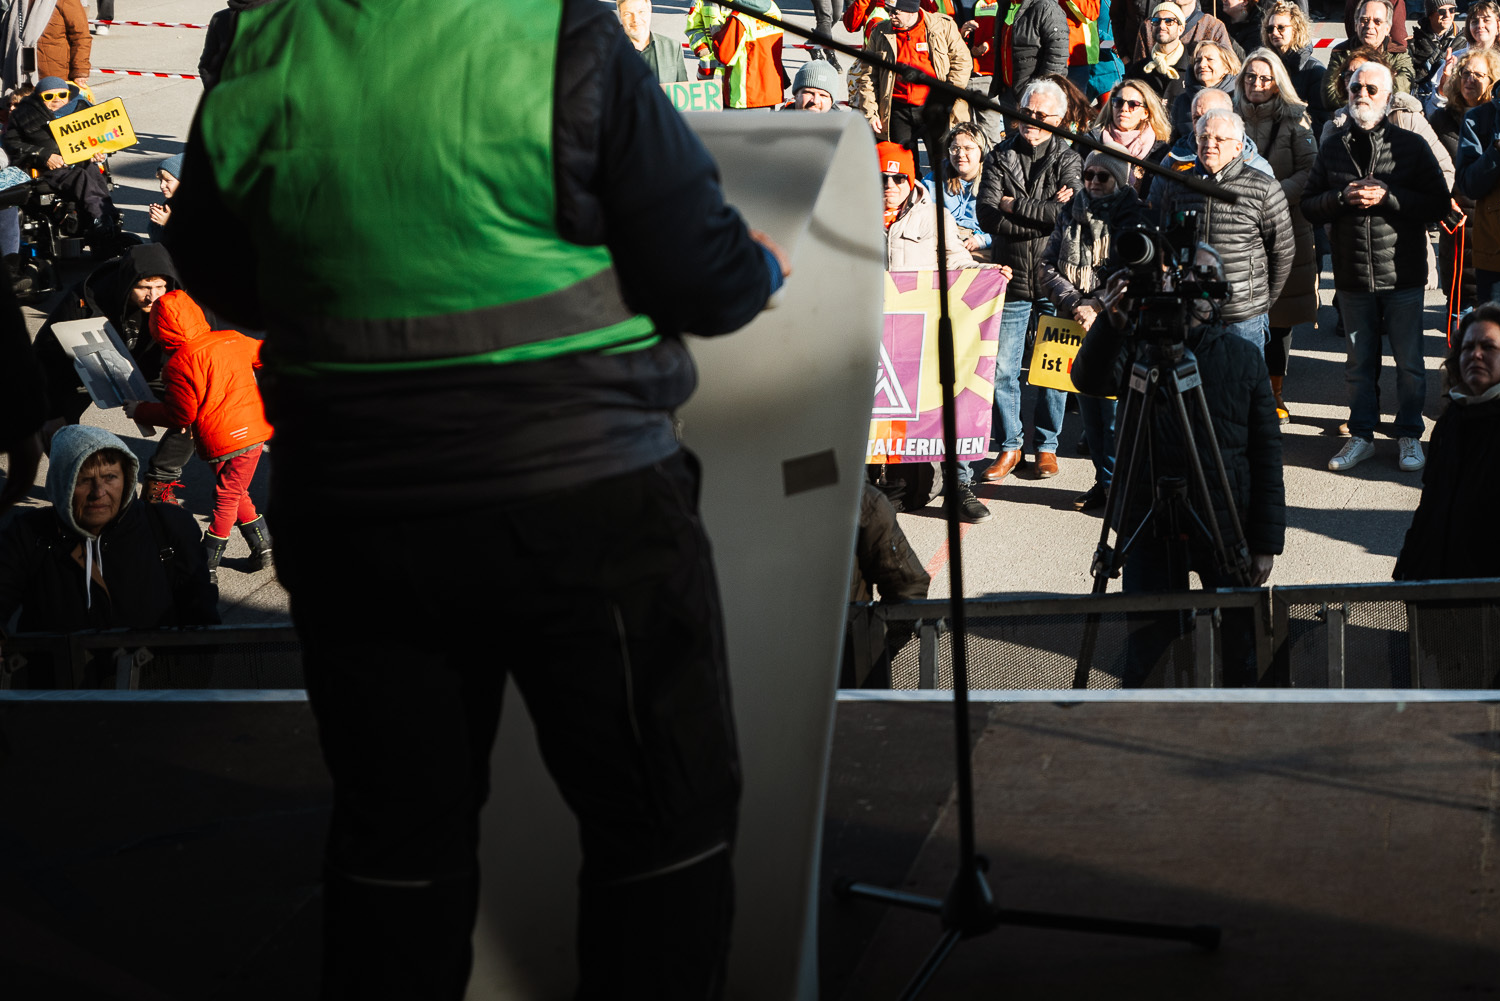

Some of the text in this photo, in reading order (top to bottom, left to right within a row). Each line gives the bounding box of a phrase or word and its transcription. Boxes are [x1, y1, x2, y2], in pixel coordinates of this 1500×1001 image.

[58, 106, 121, 138] München
[68, 124, 125, 154] ist bunt!
[1042, 353, 1063, 373] ist
